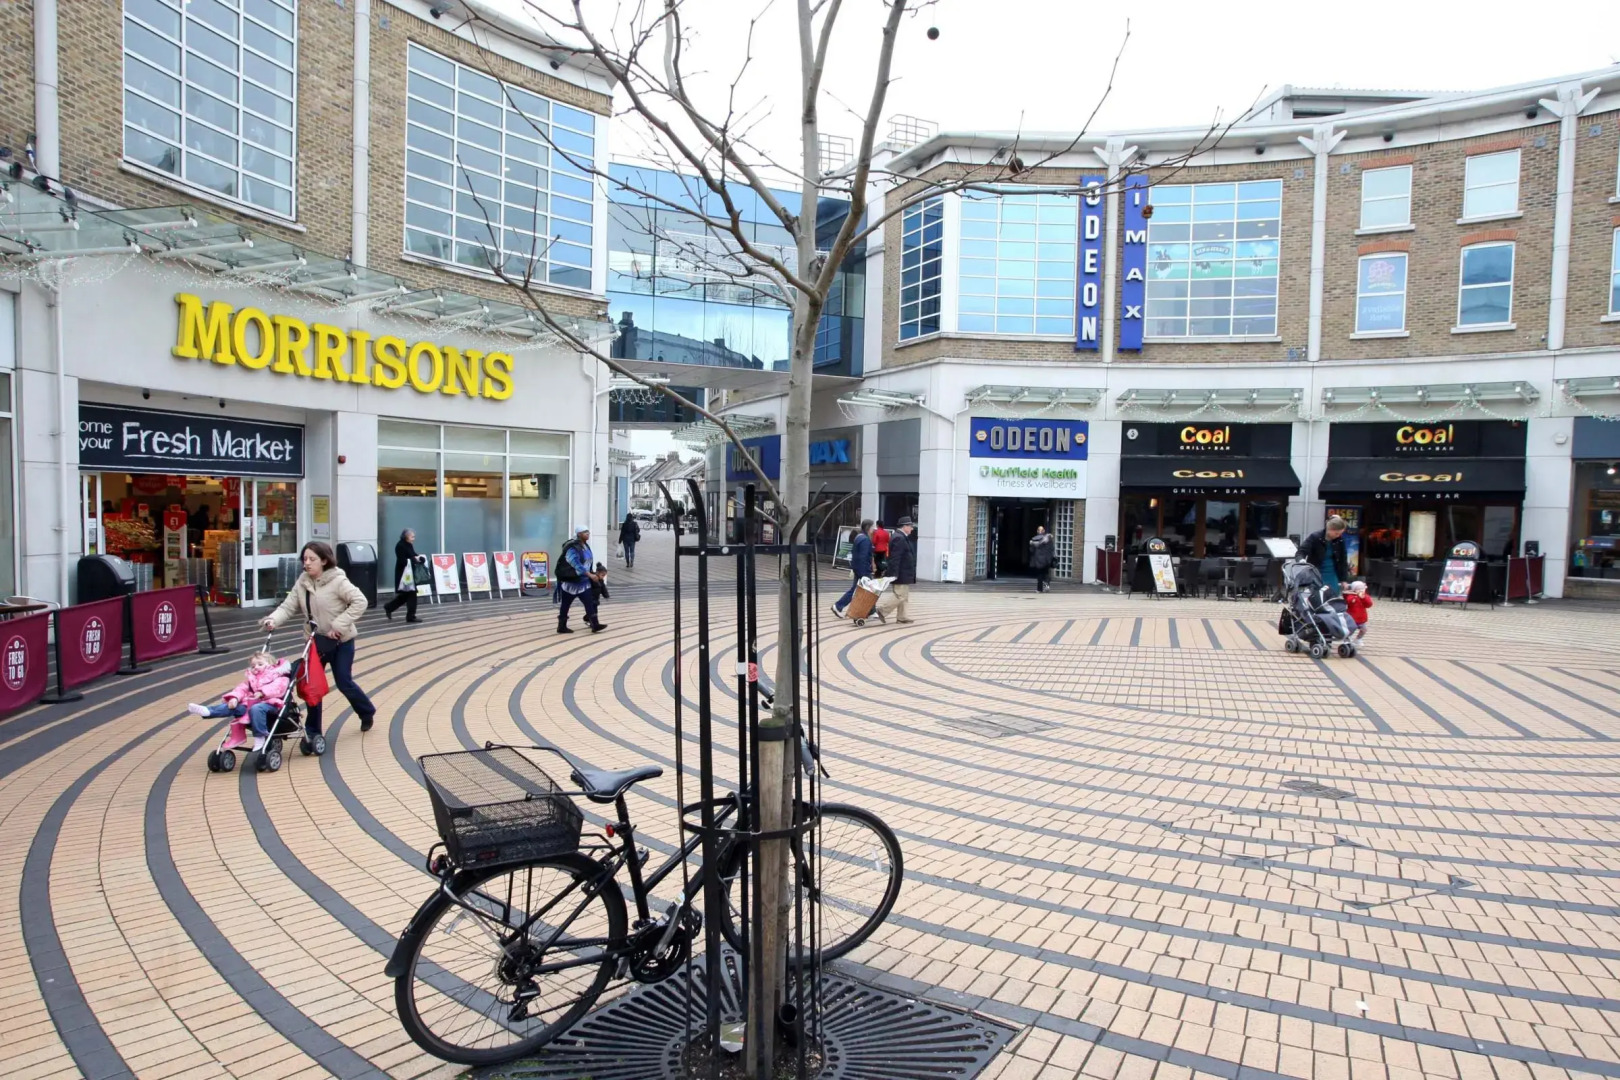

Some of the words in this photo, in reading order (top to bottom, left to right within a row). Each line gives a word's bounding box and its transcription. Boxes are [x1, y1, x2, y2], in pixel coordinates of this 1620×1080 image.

[1081, 181, 1100, 341] ODEON
[1124, 192, 1147, 320] IMAX
[172, 292, 515, 400] MORRISONS
[78, 420, 113, 434] ome
[1396, 424, 1454, 444] Coal
[122, 421, 201, 455] Fresh
[211, 427, 294, 461] Market
[990, 425, 1071, 452] ODEON
[1180, 425, 1230, 444] Coal
[78, 437, 114, 451] your
[991, 466, 1039, 479] Nuffield
[1042, 468, 1078, 480] Health
[1172, 469, 1244, 478] Coal
[1379, 472, 1463, 482] Coal
[997, 479, 1025, 488] fitness
[1026, 479, 1033, 488] &
[1035, 480, 1077, 491] wellbeing
[158, 612, 172, 623] FRESH
[86, 629, 101, 642] FRESH
[158, 623, 165, 634] TO
[165, 623, 172, 634] GO
[85, 642, 92, 654] TO
[93, 641, 100, 653] GO
[8, 650, 25, 665] FRESH
[8, 665, 16, 680] TO
[17, 664, 25, 679] GO
